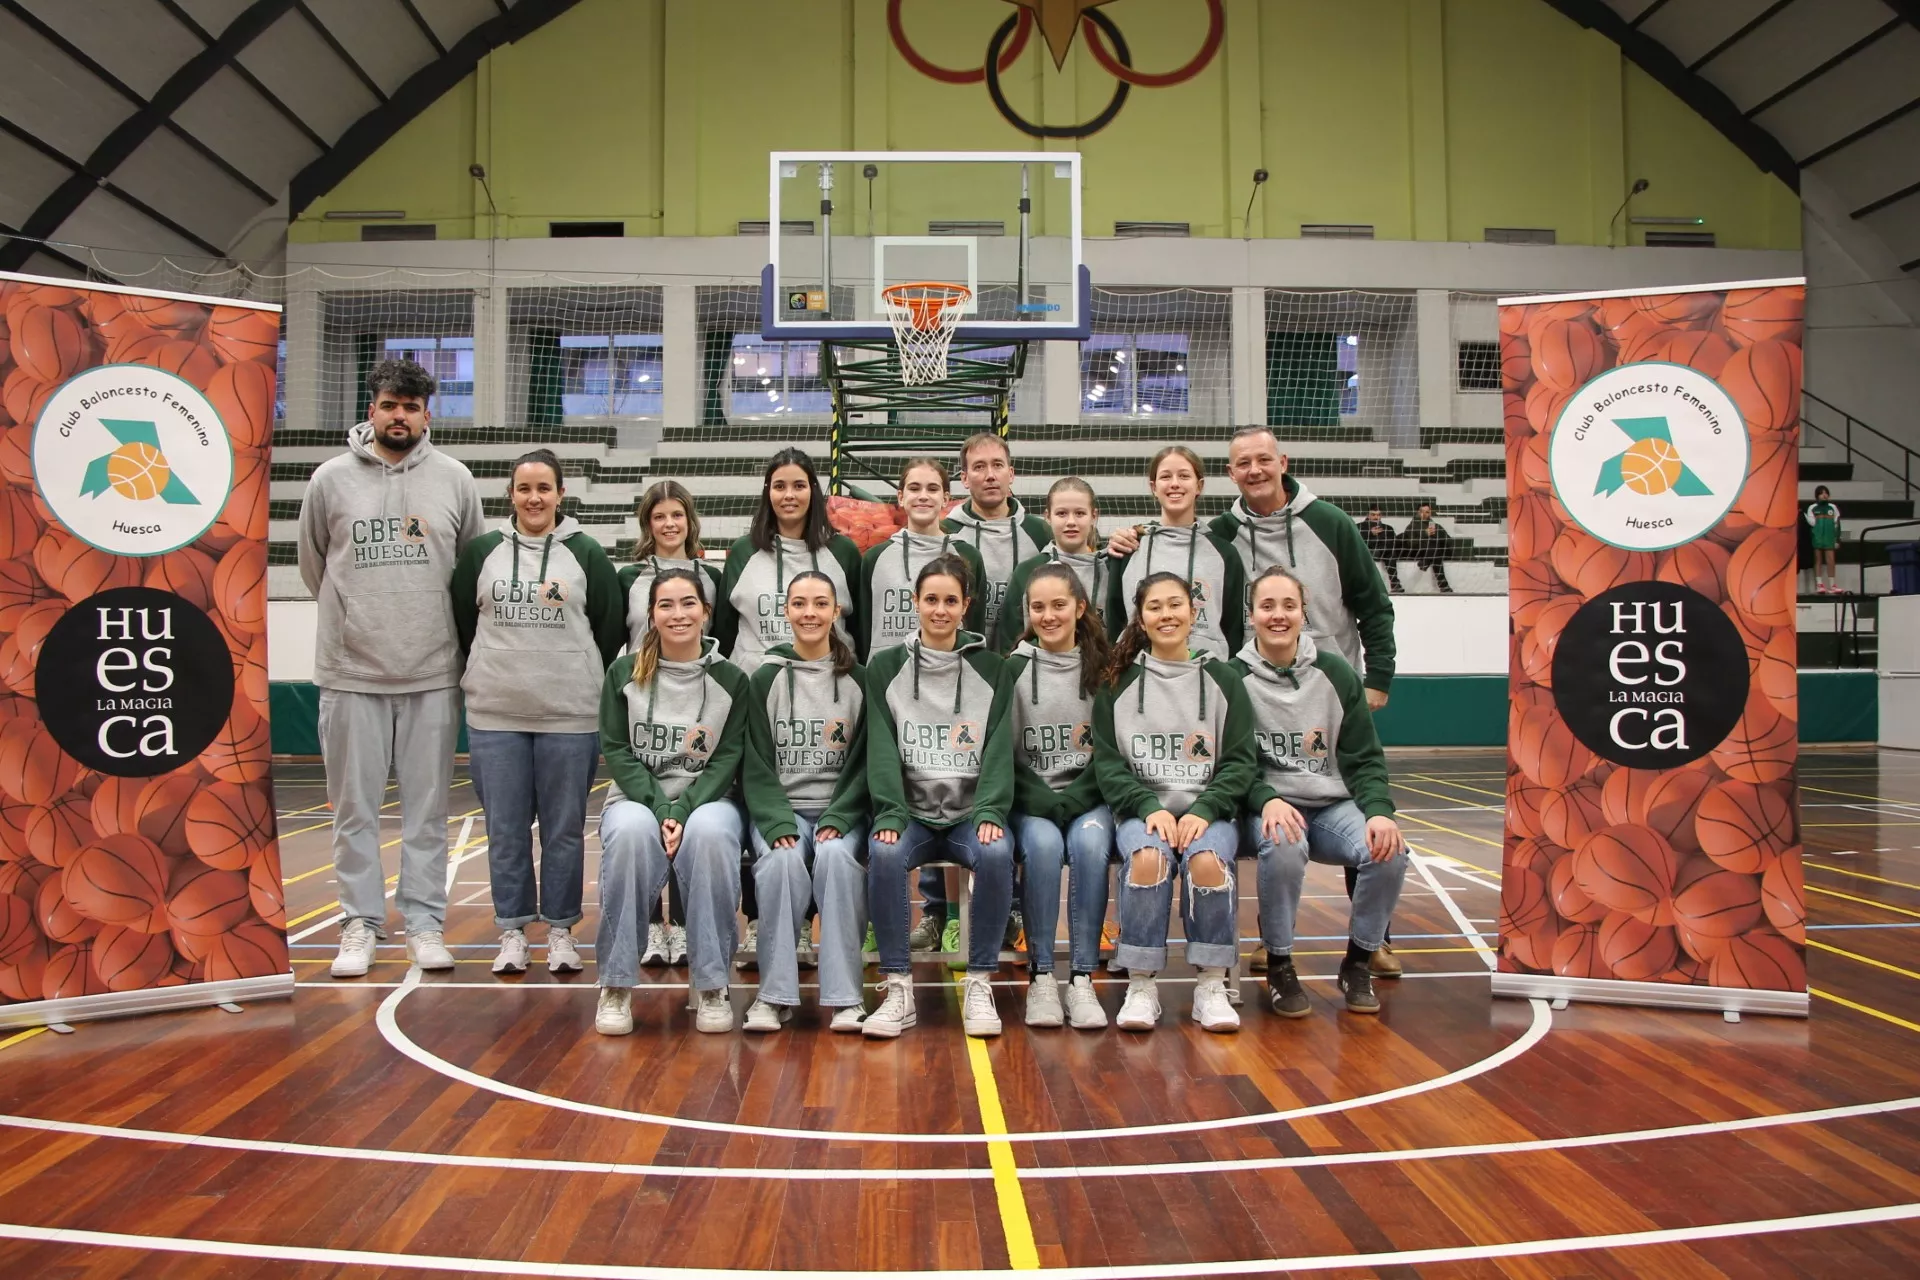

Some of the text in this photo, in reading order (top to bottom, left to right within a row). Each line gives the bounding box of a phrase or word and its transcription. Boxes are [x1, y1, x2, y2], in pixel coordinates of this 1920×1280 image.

[59, 386, 209, 447] Club Baloncesto Femenino
[1574, 382, 1722, 441] Club Baloncesto Femenino
[112, 520, 162, 535] Huesca
[352, 517, 401, 544] CBF
[1626, 516, 1674, 529] Huesca
[354, 544, 429, 561] HUESCA
[492, 579, 541, 603] CBF
[884, 588, 915, 613] CB
[493, 605, 565, 622] HUESCA
[757, 593, 788, 617] CB
[760, 620, 793, 634] HUE
[882, 616, 918, 630] HUE
[96, 646, 174, 692] es
[1609, 640, 1686, 686] es
[97, 714, 179, 758] ca
[633, 722, 686, 752] CBF
[775, 719, 825, 747] CBF
[902, 720, 951, 750] CBF
[1023, 724, 1073, 753] CBF
[1609, 707, 1690, 750] ca
[1131, 733, 1185, 761] CBF
[1254, 731, 1303, 757] CBF
[777, 750, 846, 766] HUESCA
[903, 749, 980, 767] HUESCA
[1028, 753, 1087, 771] HUESC
[1133, 763, 1212, 778] HUESCA
